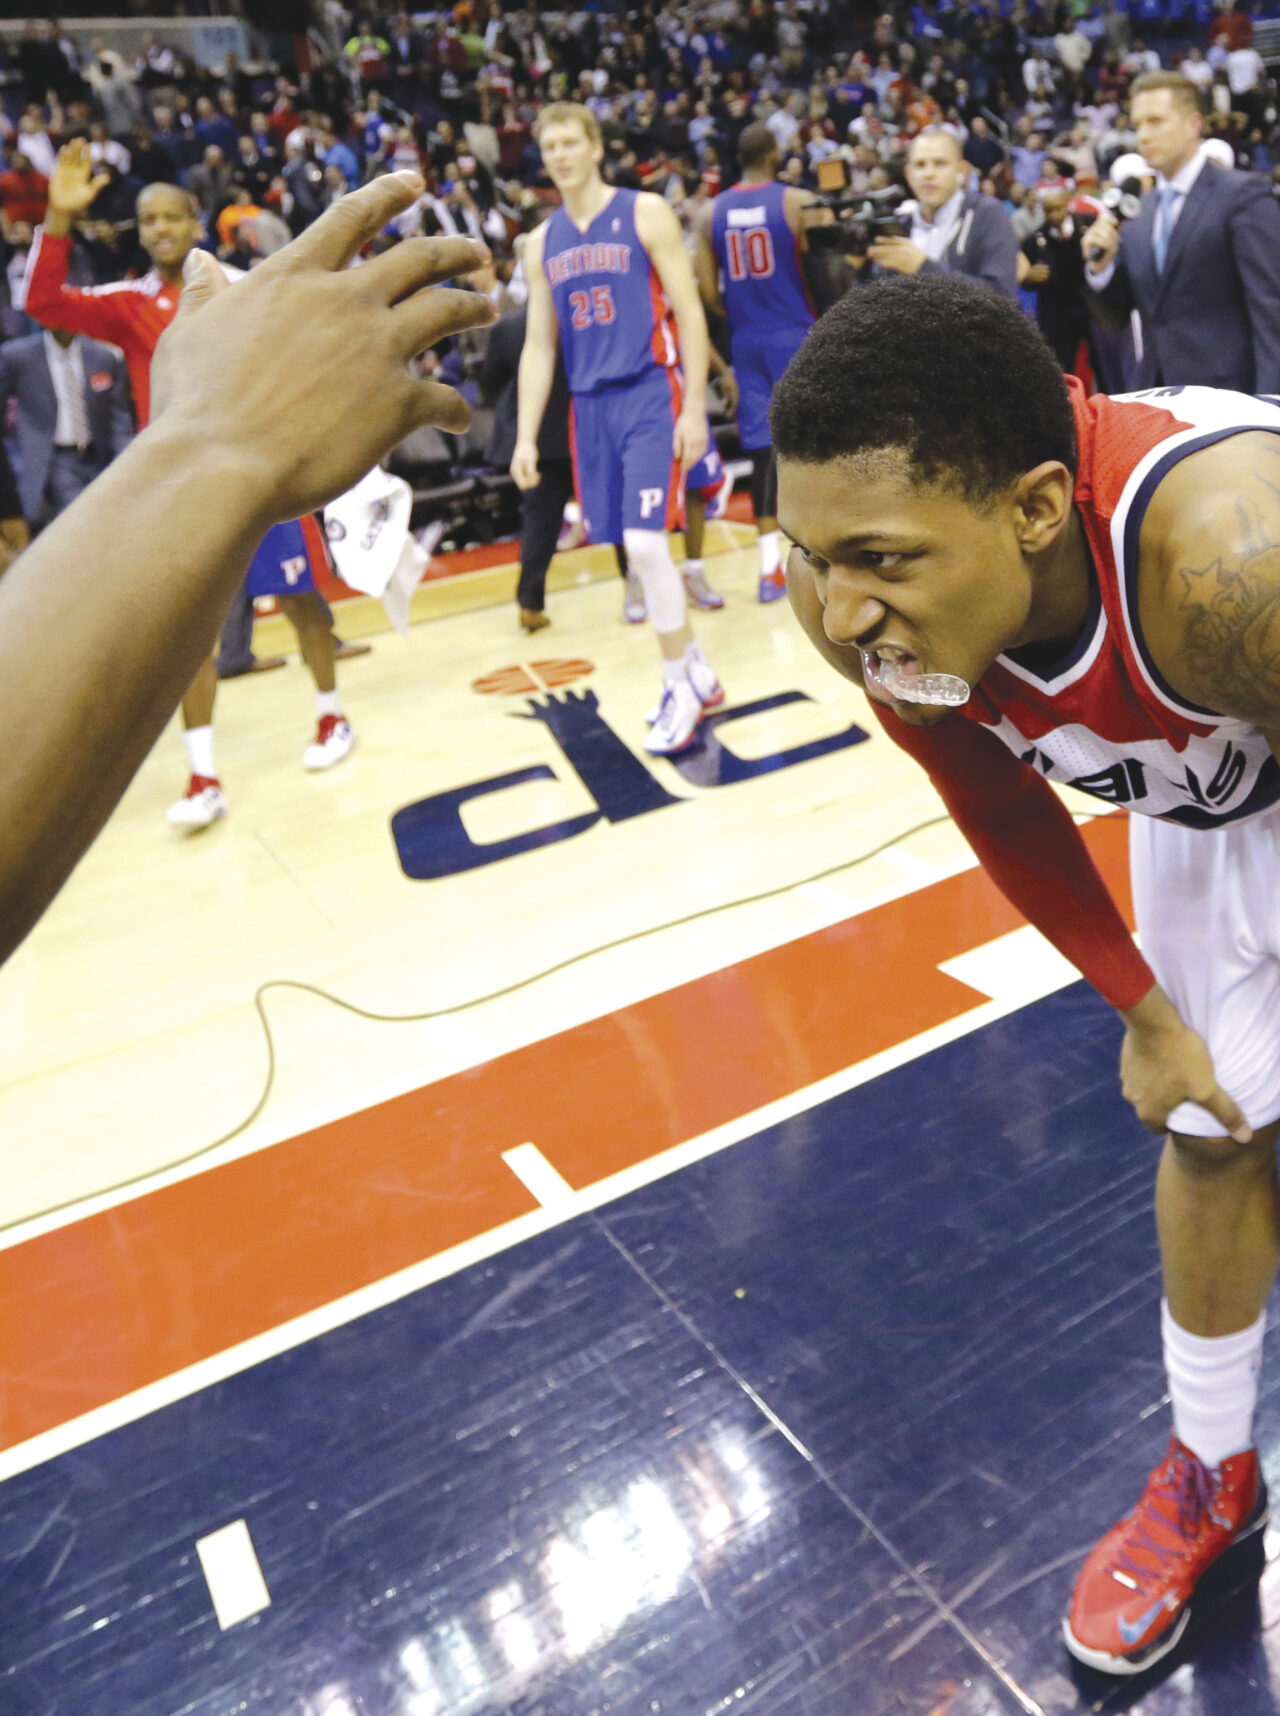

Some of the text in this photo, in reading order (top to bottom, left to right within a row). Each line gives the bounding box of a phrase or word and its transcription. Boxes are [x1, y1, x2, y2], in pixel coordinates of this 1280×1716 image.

[545, 243, 632, 286] DETROIT
[725, 227, 775, 281] 10
[568, 285, 616, 330] 25
[638, 488, 664, 519] P
[280, 555, 306, 586] P
